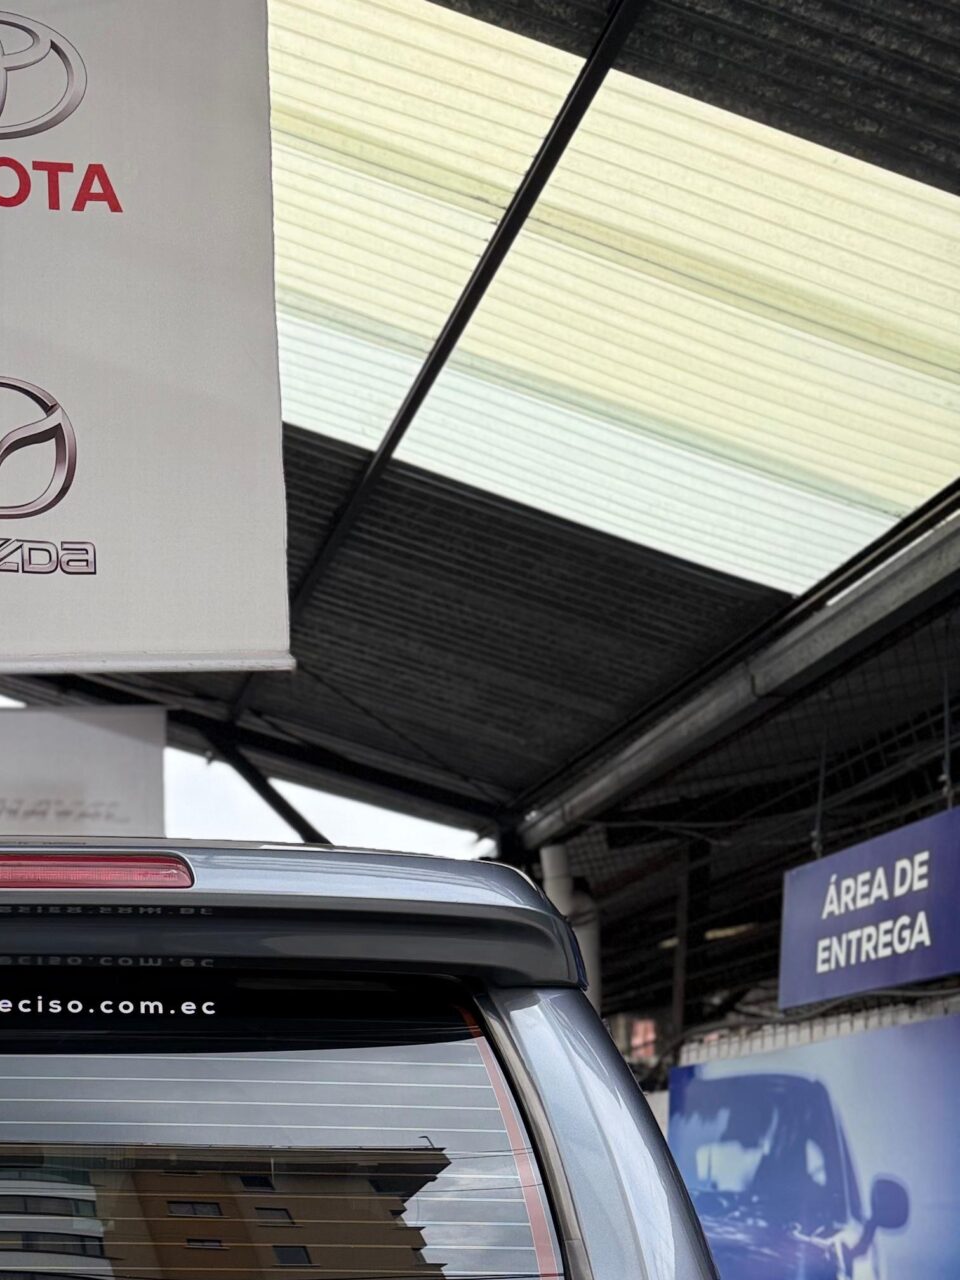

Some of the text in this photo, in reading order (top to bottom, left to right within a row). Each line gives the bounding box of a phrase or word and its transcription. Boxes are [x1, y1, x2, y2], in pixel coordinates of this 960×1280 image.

[821, 850, 930, 920] ÁREA DE
[816, 910, 932, 973] ENTREGA
